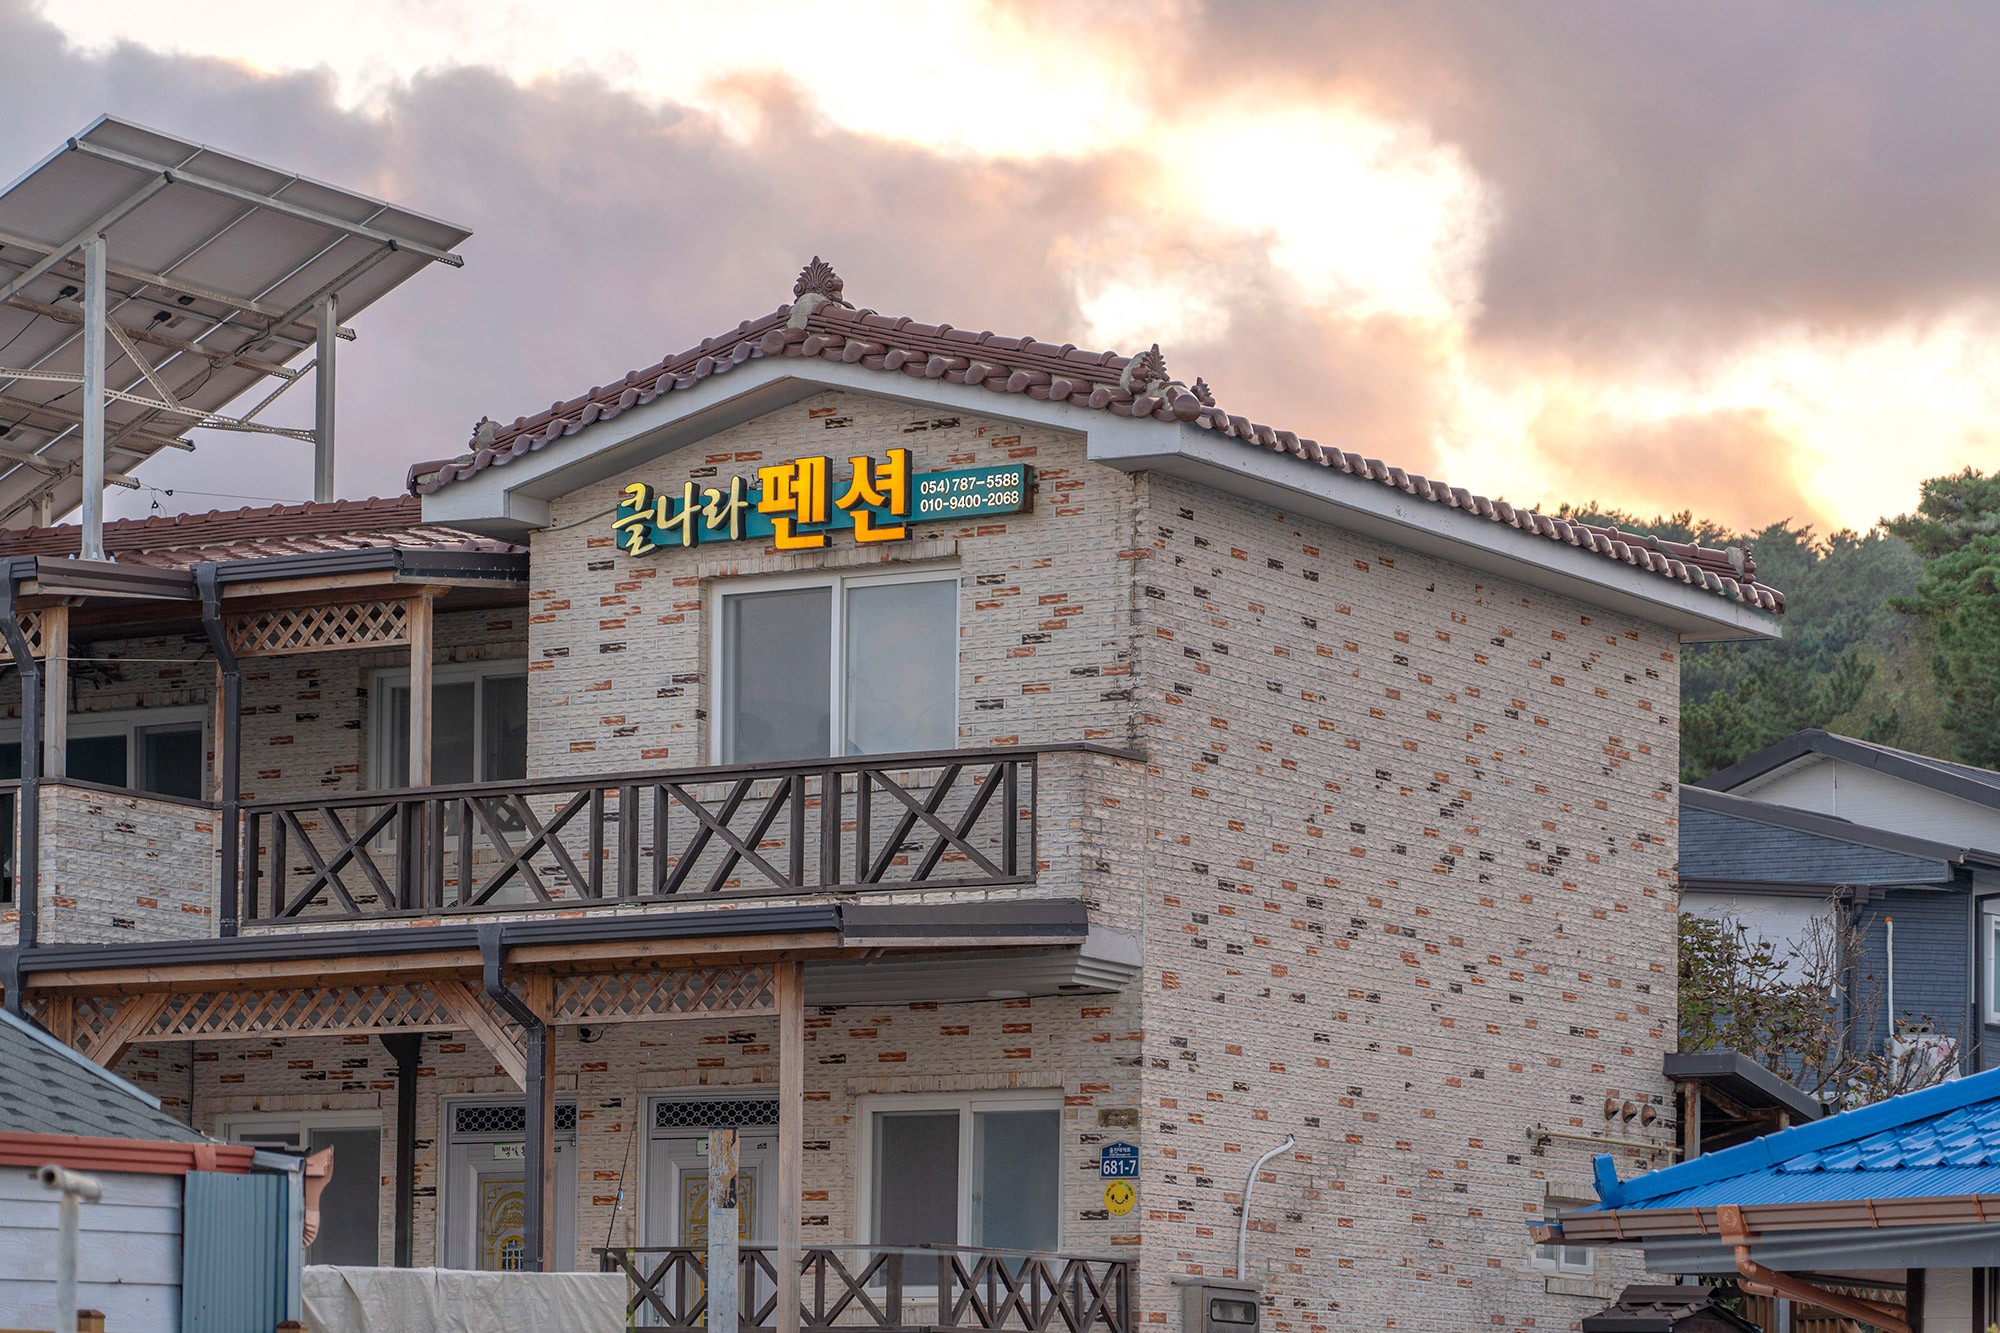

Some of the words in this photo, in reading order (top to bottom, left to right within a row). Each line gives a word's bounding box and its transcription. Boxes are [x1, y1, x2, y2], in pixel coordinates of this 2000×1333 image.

[758, 448, 909, 550] 펜션
[920, 501, 1019, 523] 010-9400-2068
[1103, 1160, 1136, 1174] 681-7
